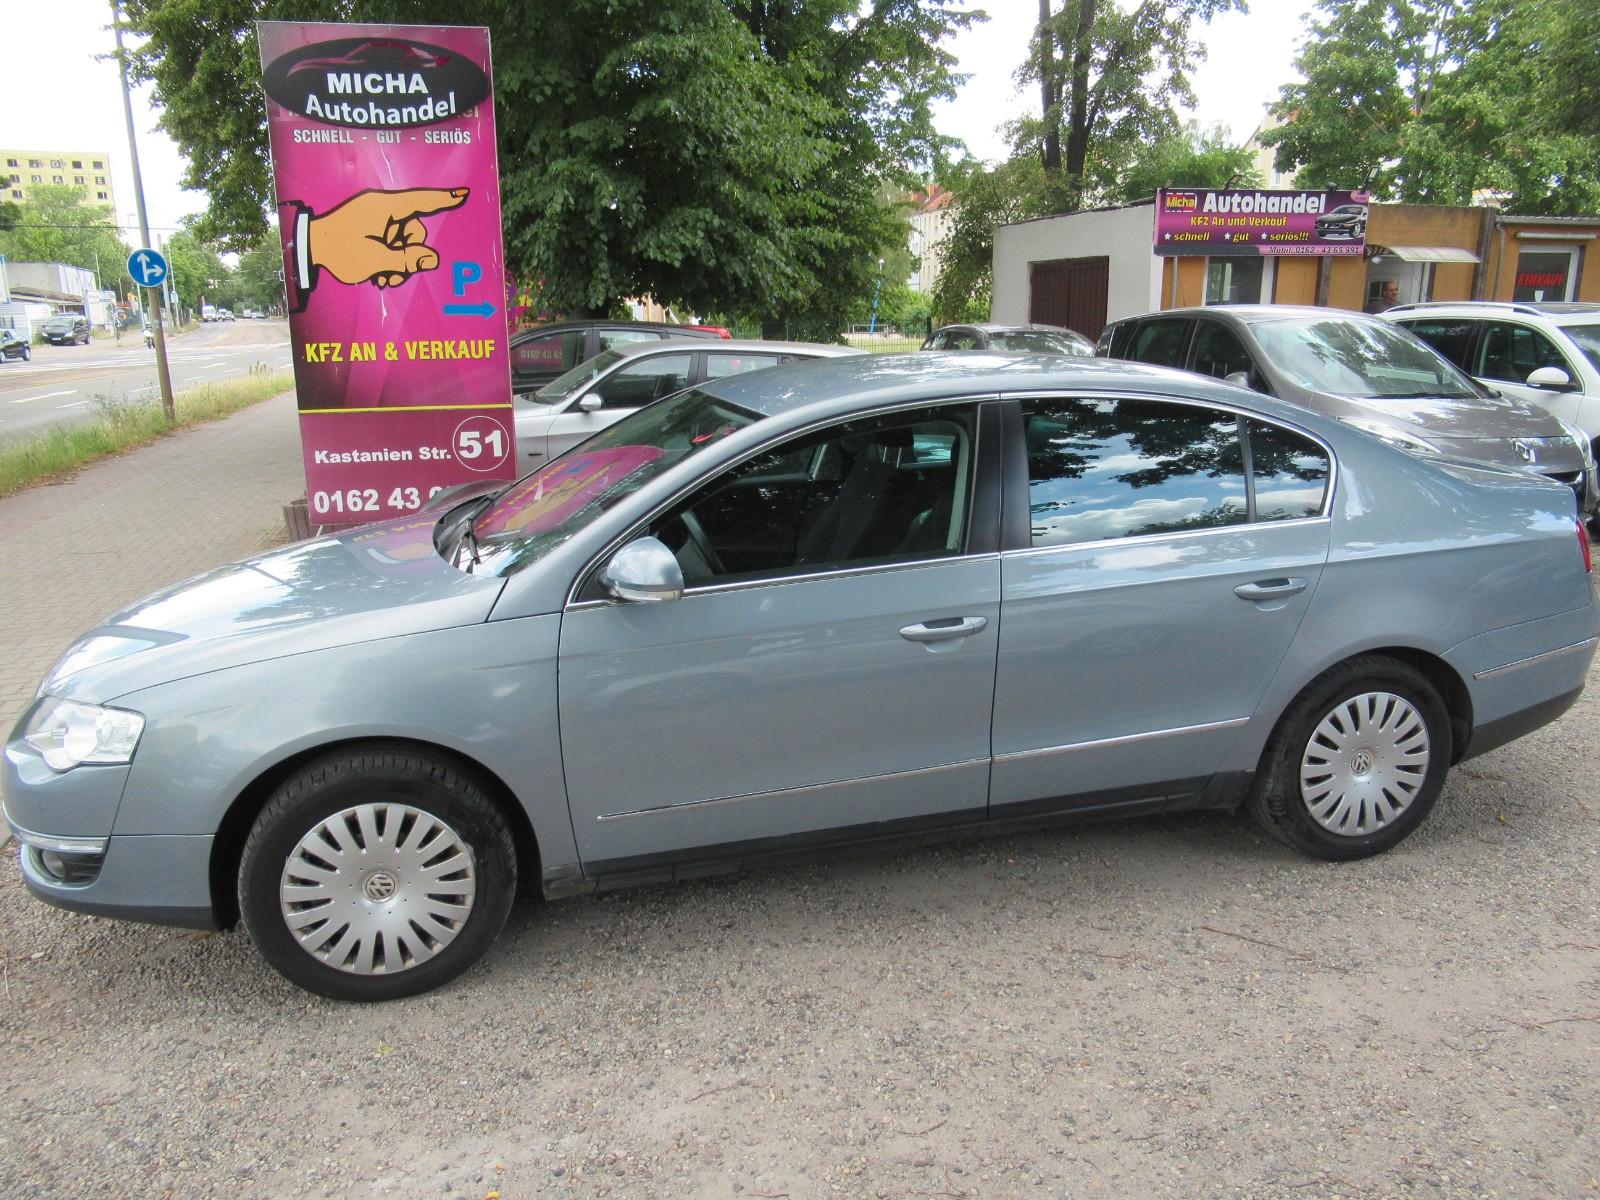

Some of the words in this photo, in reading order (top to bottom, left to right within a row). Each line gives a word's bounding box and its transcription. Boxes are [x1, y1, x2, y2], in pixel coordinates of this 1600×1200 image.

[327, 73, 428, 94] MICHA
[305, 92, 456, 125] Autohandel
[293, 129, 354, 143] SCHNELL
[376, 130, 401, 144] GUT
[424, 128, 471, 144] SERIÖS
[1166, 196, 1195, 208] Micha
[1203, 193, 1326, 213] Autohandel
[1190, 216, 1209, 226] KFZ
[1212, 216, 1225, 226] An
[1228, 216, 1246, 226] und
[1249, 216, 1287, 226] Verkauf
[1174, 232, 1210, 241] schnell
[1233, 232, 1249, 242] gut
[1270, 231, 1309, 241] seriös!!!
[452, 261, 482, 296] P
[305, 342, 344, 363] KFZ
[349, 342, 377, 361] AN
[384, 342, 398, 361] &
[405, 339, 495, 361] VERKAUF
[315, 447, 412, 464] Kastanien
[419, 446, 452, 460] Str.
[459, 430, 503, 458] 51
[314, 489, 380, 513] 0162
[387, 487, 421, 510] 43
